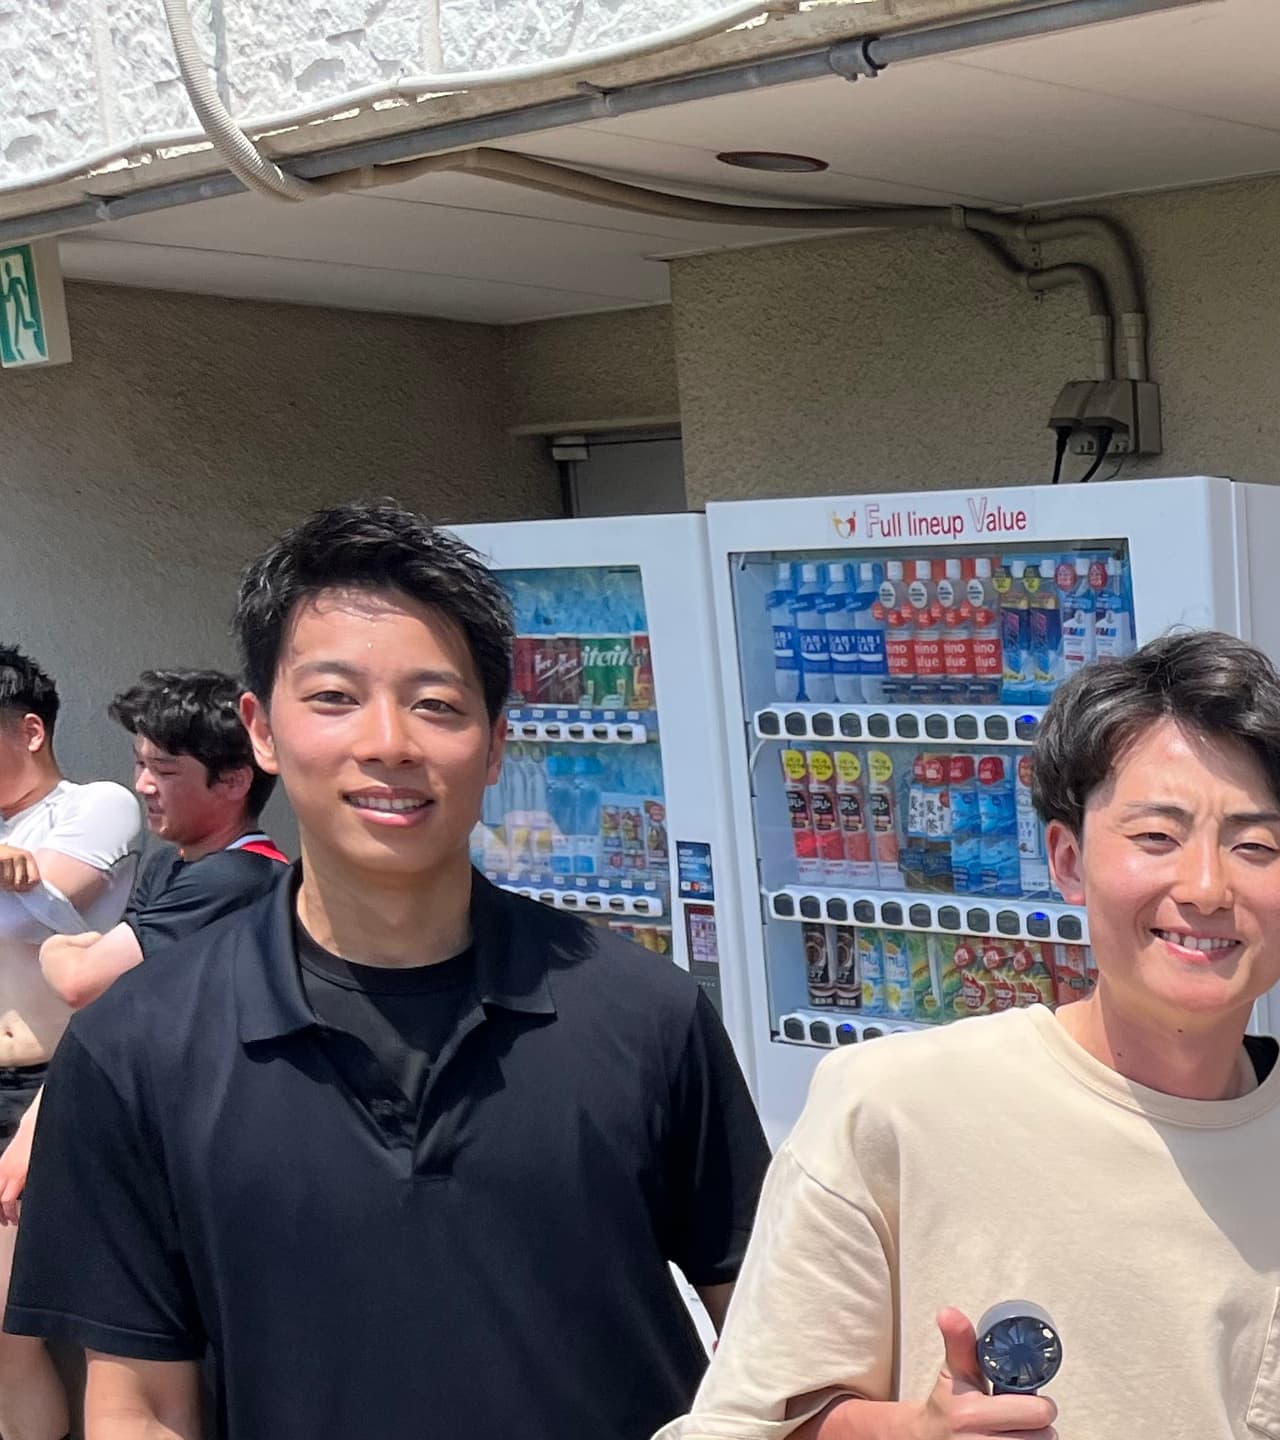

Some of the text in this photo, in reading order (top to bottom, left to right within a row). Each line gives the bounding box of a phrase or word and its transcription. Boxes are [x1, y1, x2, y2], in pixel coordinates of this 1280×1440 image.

[865, 497, 1027, 540] Full lineup Value
